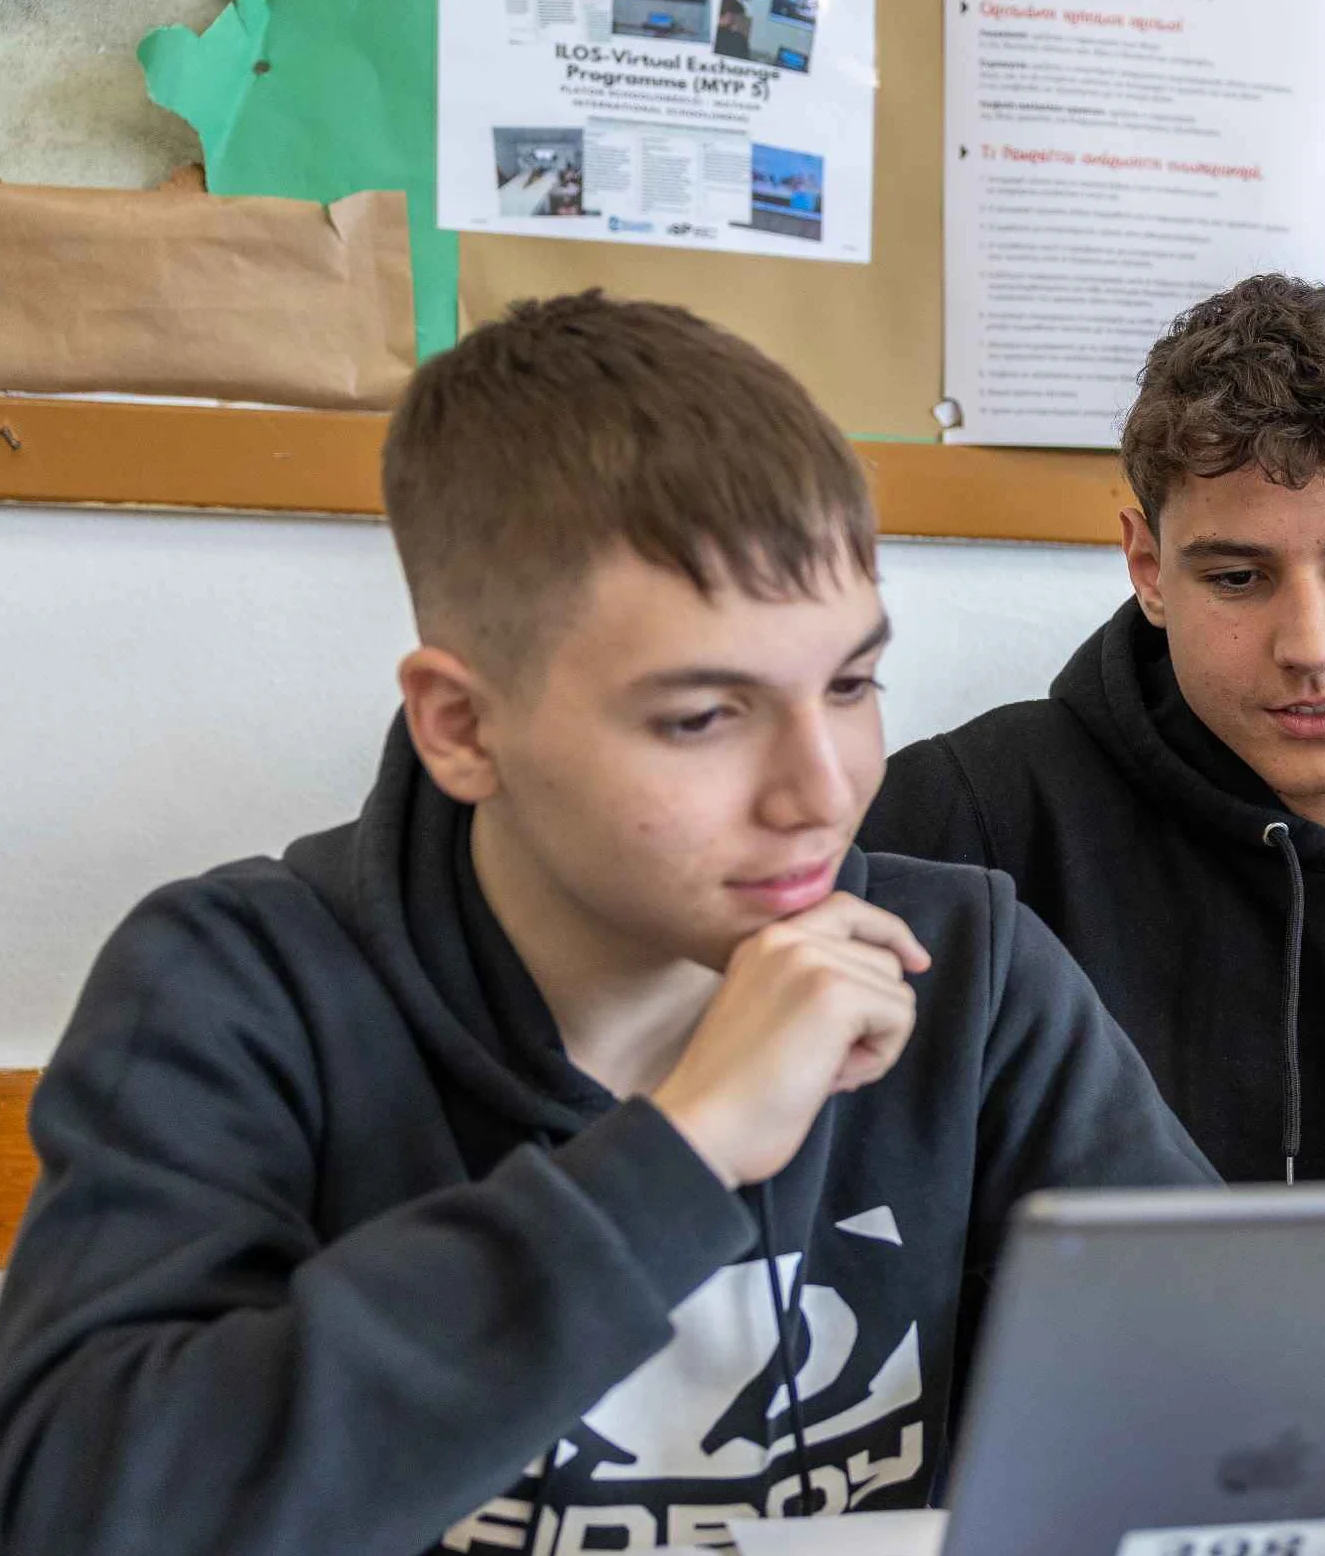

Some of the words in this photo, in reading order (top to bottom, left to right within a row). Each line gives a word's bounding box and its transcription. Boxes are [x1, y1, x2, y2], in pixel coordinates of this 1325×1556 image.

[555, 42, 681, 72] ILOS-Virtual
[686, 56, 781, 84] Exchange
[566, 64, 687, 90] Programme
[693, 77, 746, 96] (MYP
